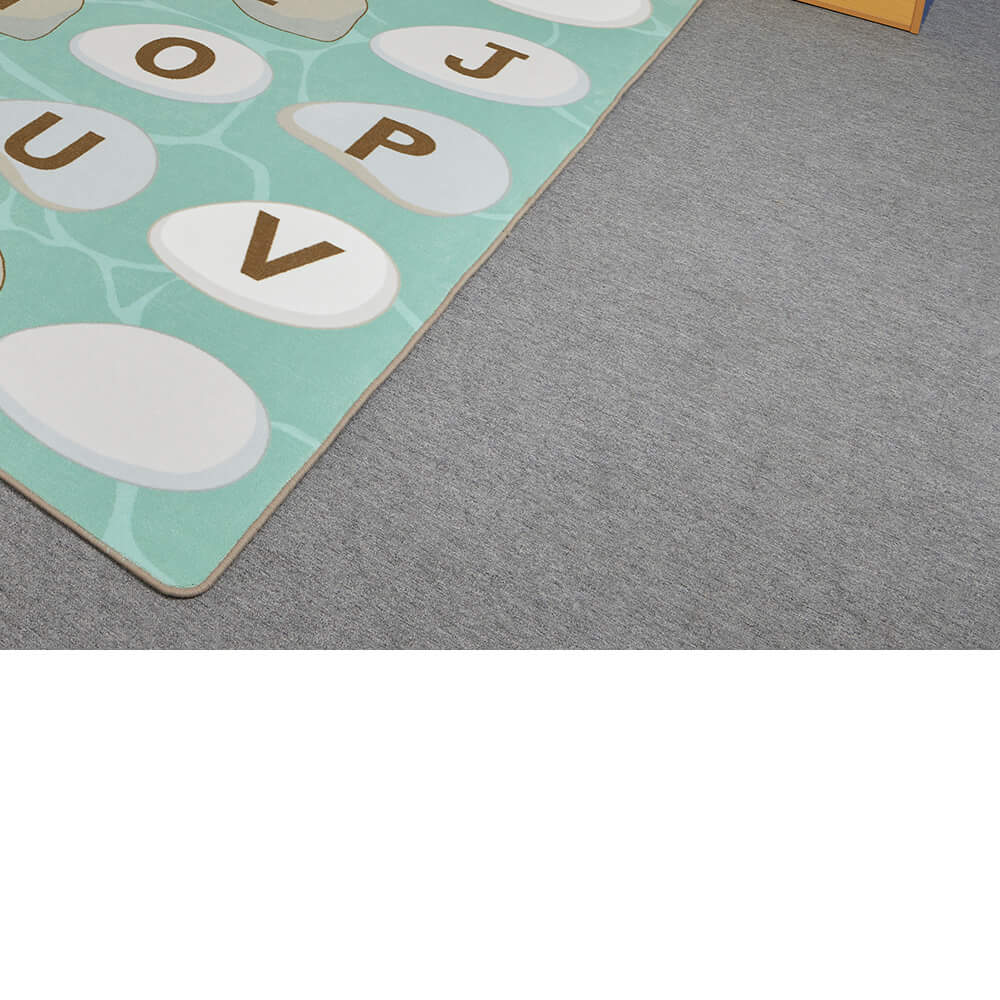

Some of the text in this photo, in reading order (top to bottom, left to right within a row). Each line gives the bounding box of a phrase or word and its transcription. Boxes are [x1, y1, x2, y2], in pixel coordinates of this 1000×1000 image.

[134, 37, 216, 80] O
[444, 42, 530, 79] J
[4, 111, 105, 171] U
[344, 116, 436, 161] P
[240, 210, 345, 281] V
